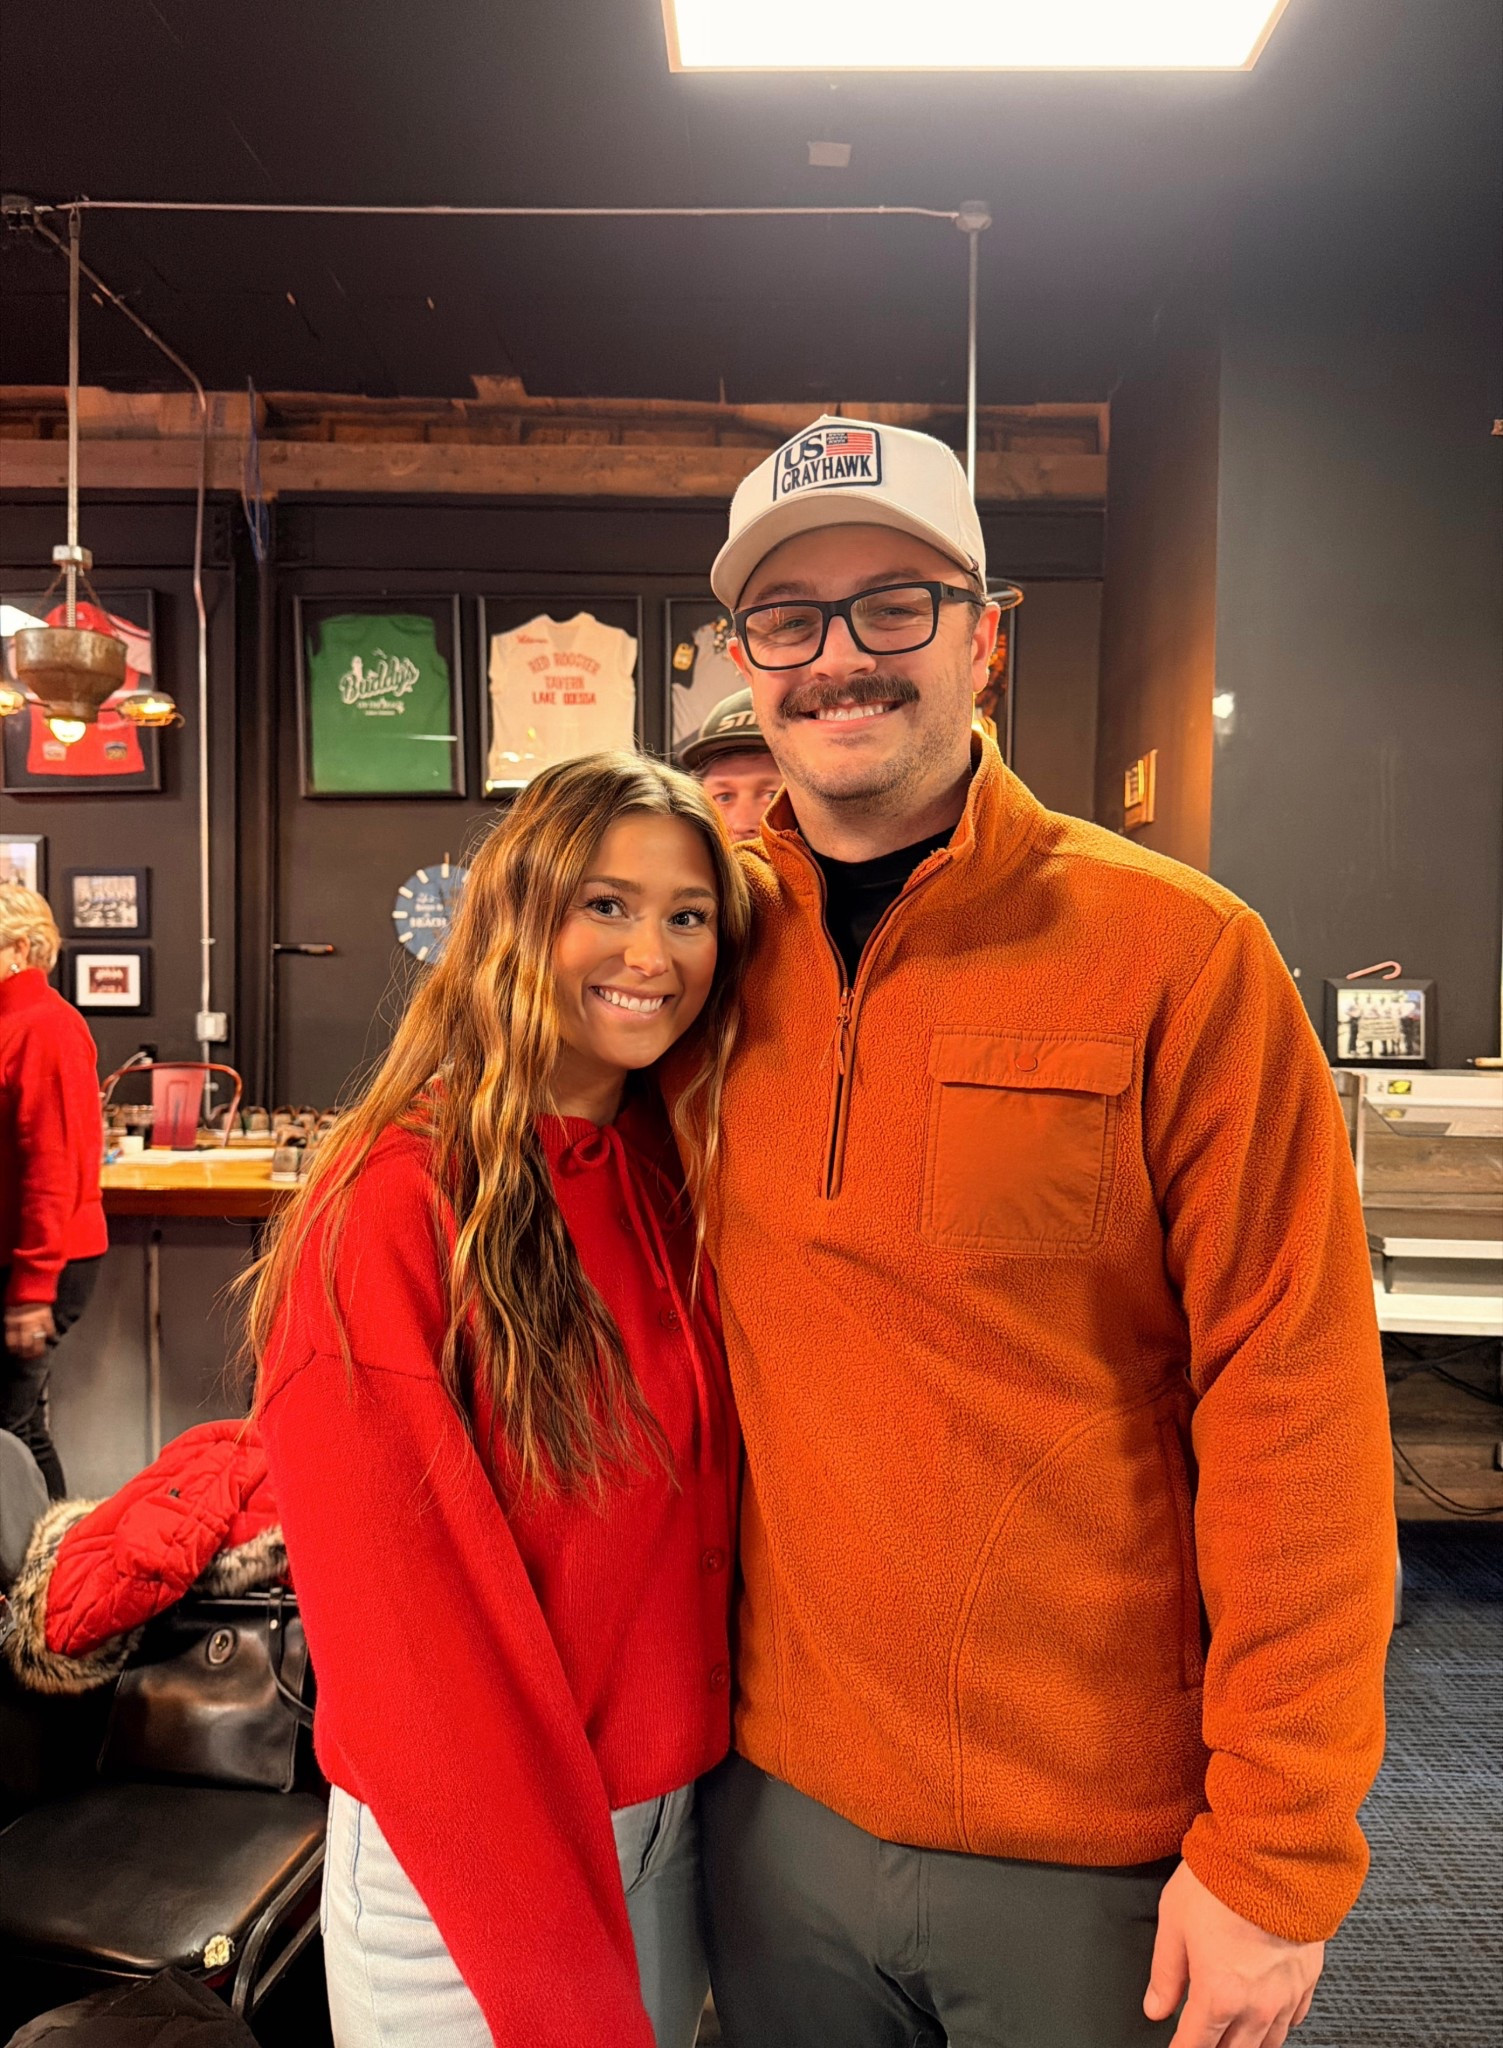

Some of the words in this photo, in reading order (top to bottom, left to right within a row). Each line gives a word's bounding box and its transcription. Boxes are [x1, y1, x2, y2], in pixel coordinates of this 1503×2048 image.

[784, 433, 824, 470] US
[781, 454, 873, 494] GRAYHAWK
[528, 655, 551, 675] RED
[553, 652, 601, 676] ROOSTER
[544, 676, 585, 690] TAVERN
[532, 691, 556, 705] LAKE
